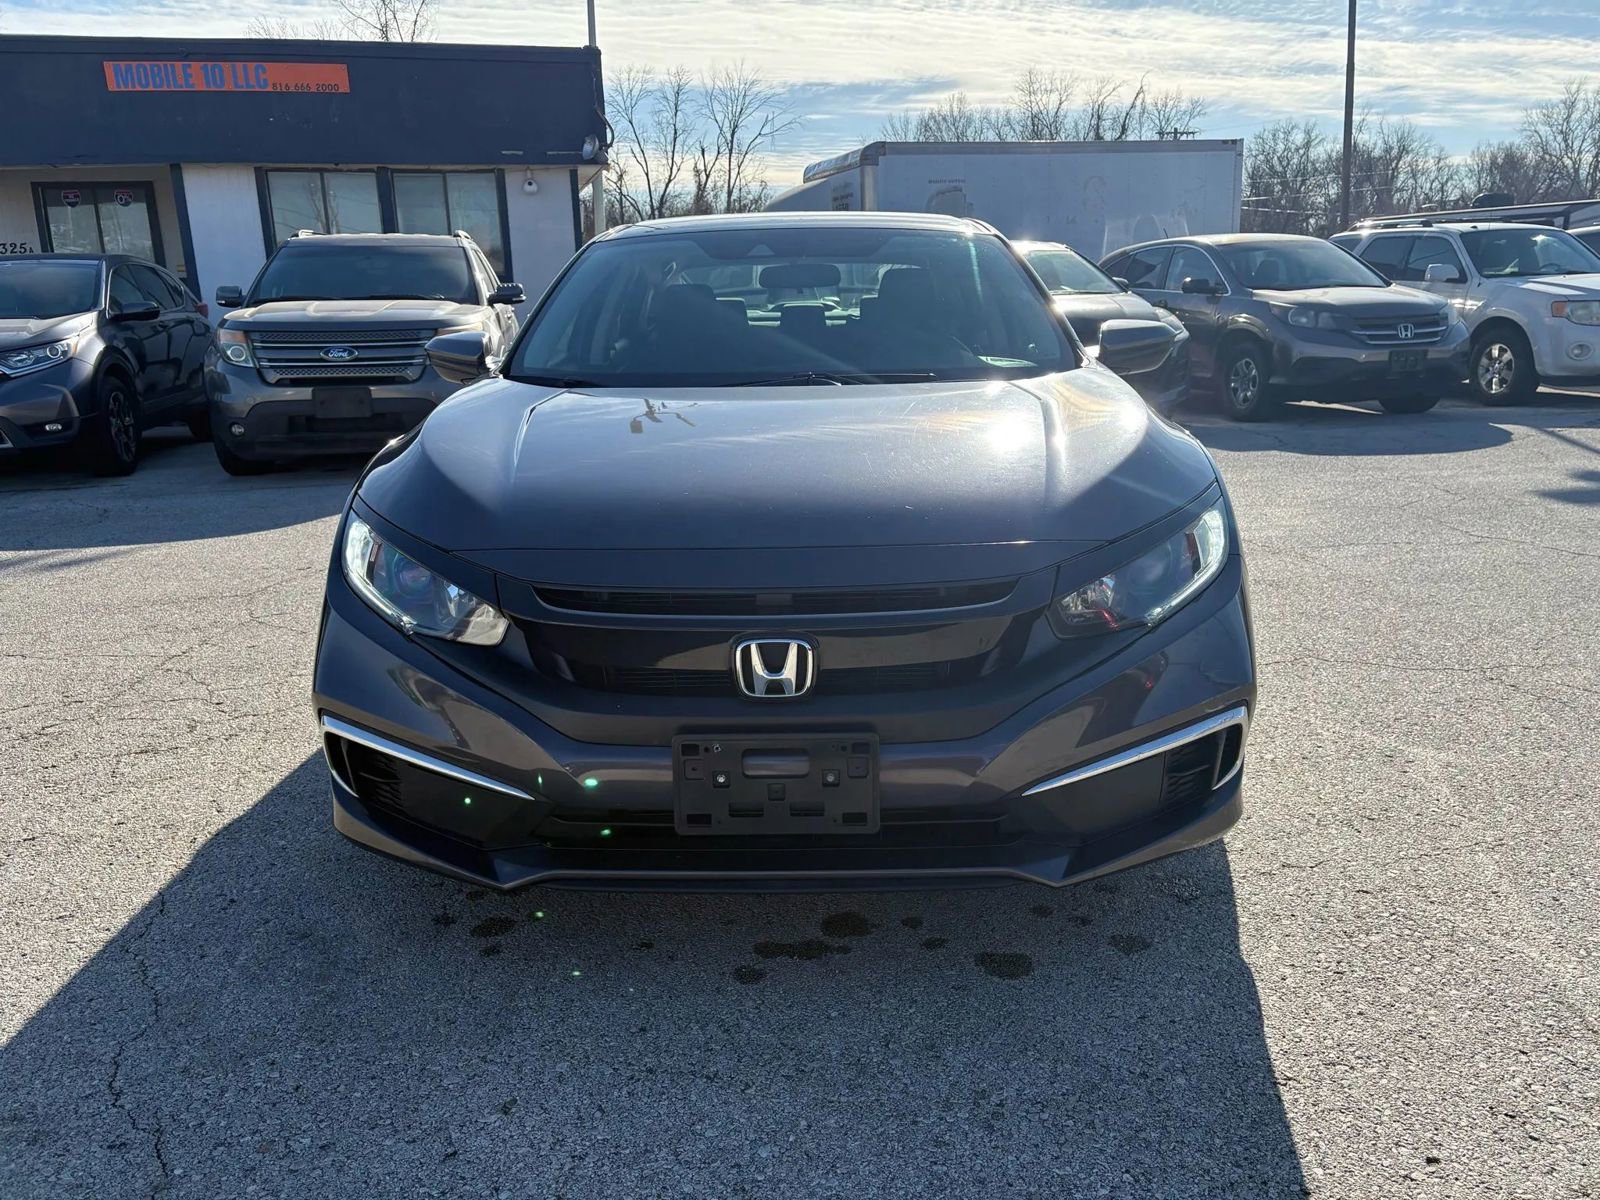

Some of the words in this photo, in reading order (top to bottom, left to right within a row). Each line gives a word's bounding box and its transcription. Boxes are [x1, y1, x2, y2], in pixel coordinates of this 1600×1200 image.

[112, 63, 198, 90] MOBILE
[202, 63, 226, 90] 10
[231, 63, 269, 90] LLC
